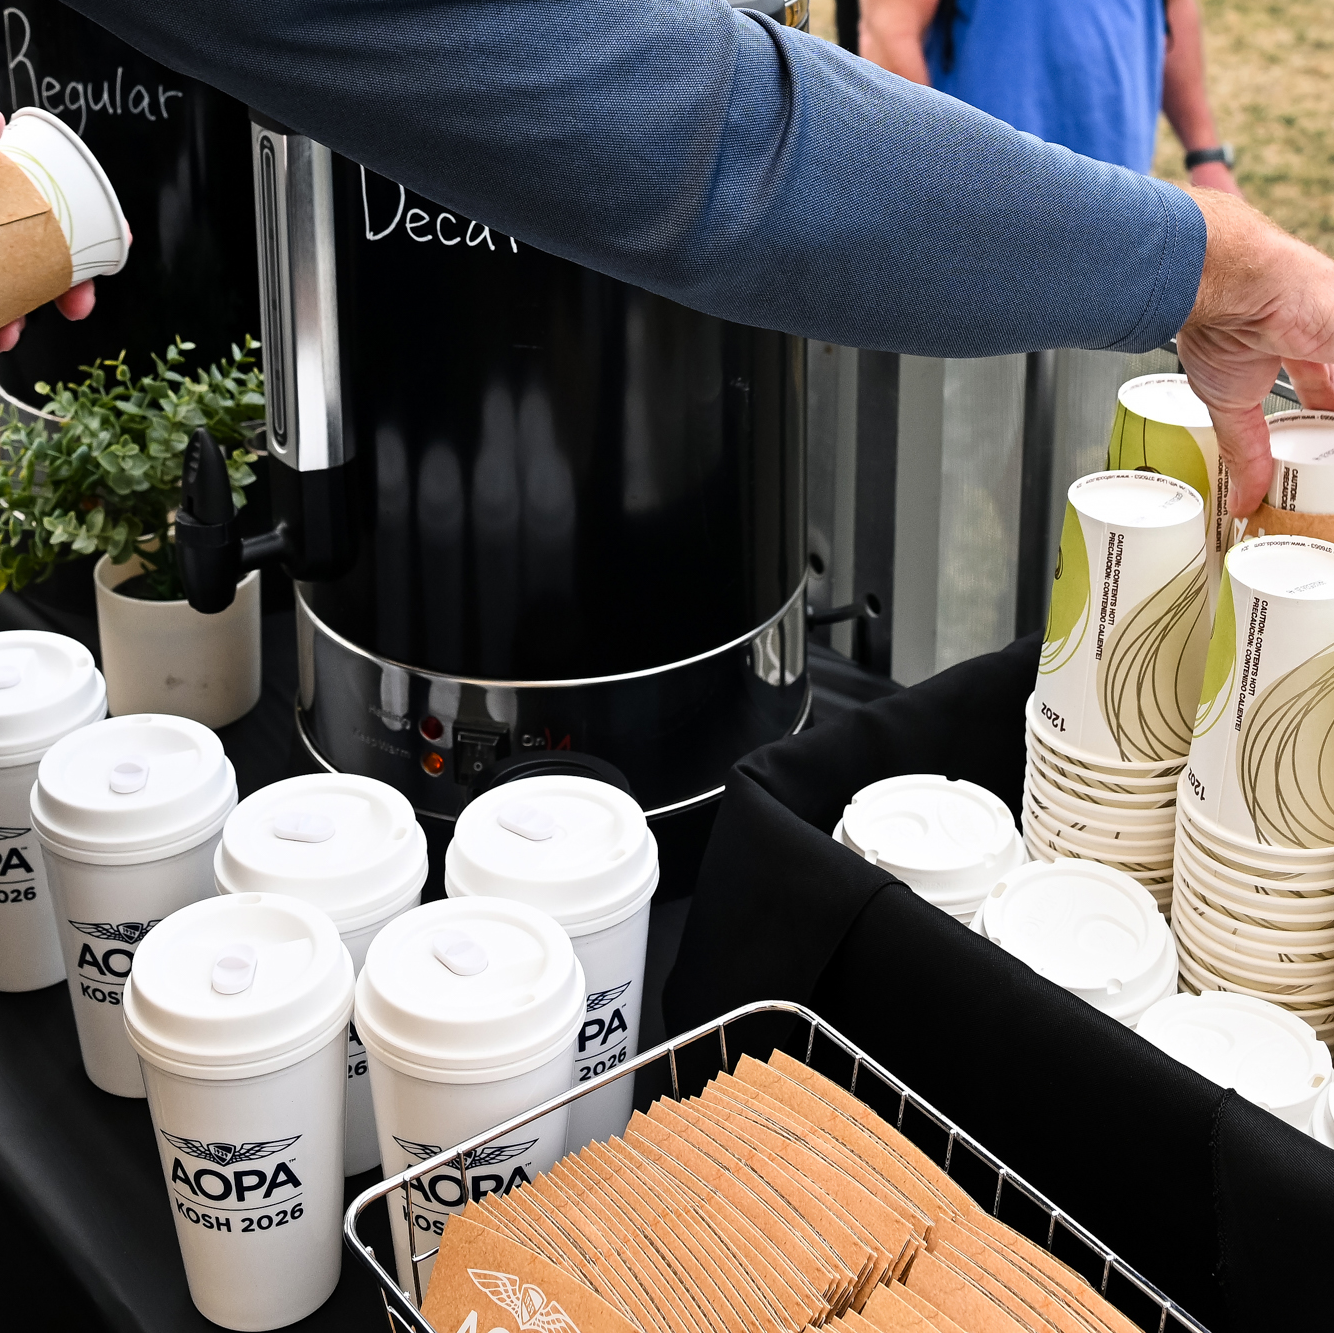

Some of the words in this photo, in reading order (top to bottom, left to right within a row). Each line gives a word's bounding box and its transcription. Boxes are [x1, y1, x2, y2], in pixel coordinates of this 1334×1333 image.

[3, 7, 183, 137] Regular
[360, 164, 518, 254] Deca
[1104, 531, 1116, 581] PRECAUCION:
[1114, 533, 1125, 568] CAUTION:
[1254, 540, 1306, 548] www.usfoods.com
[1099, 581, 1110, 623] CONTENIDO
[1110, 568, 1121, 608] CONTENTS
[1247, 596, 1260, 648] PRECAUCION:
[1257, 600, 1268, 636] CAUTION:
[1240, 648, 1252, 692] CONTENIDO
[1251, 637, 1263, 677] CONTENTS
[80, 981, 123, 1006] KOS
[578, 1046, 627, 1082] 2026
[171, 1156, 302, 1202] AOPA
[175, 1197, 232, 1233] KOSH
[240, 1202, 304, 1233] 2026
